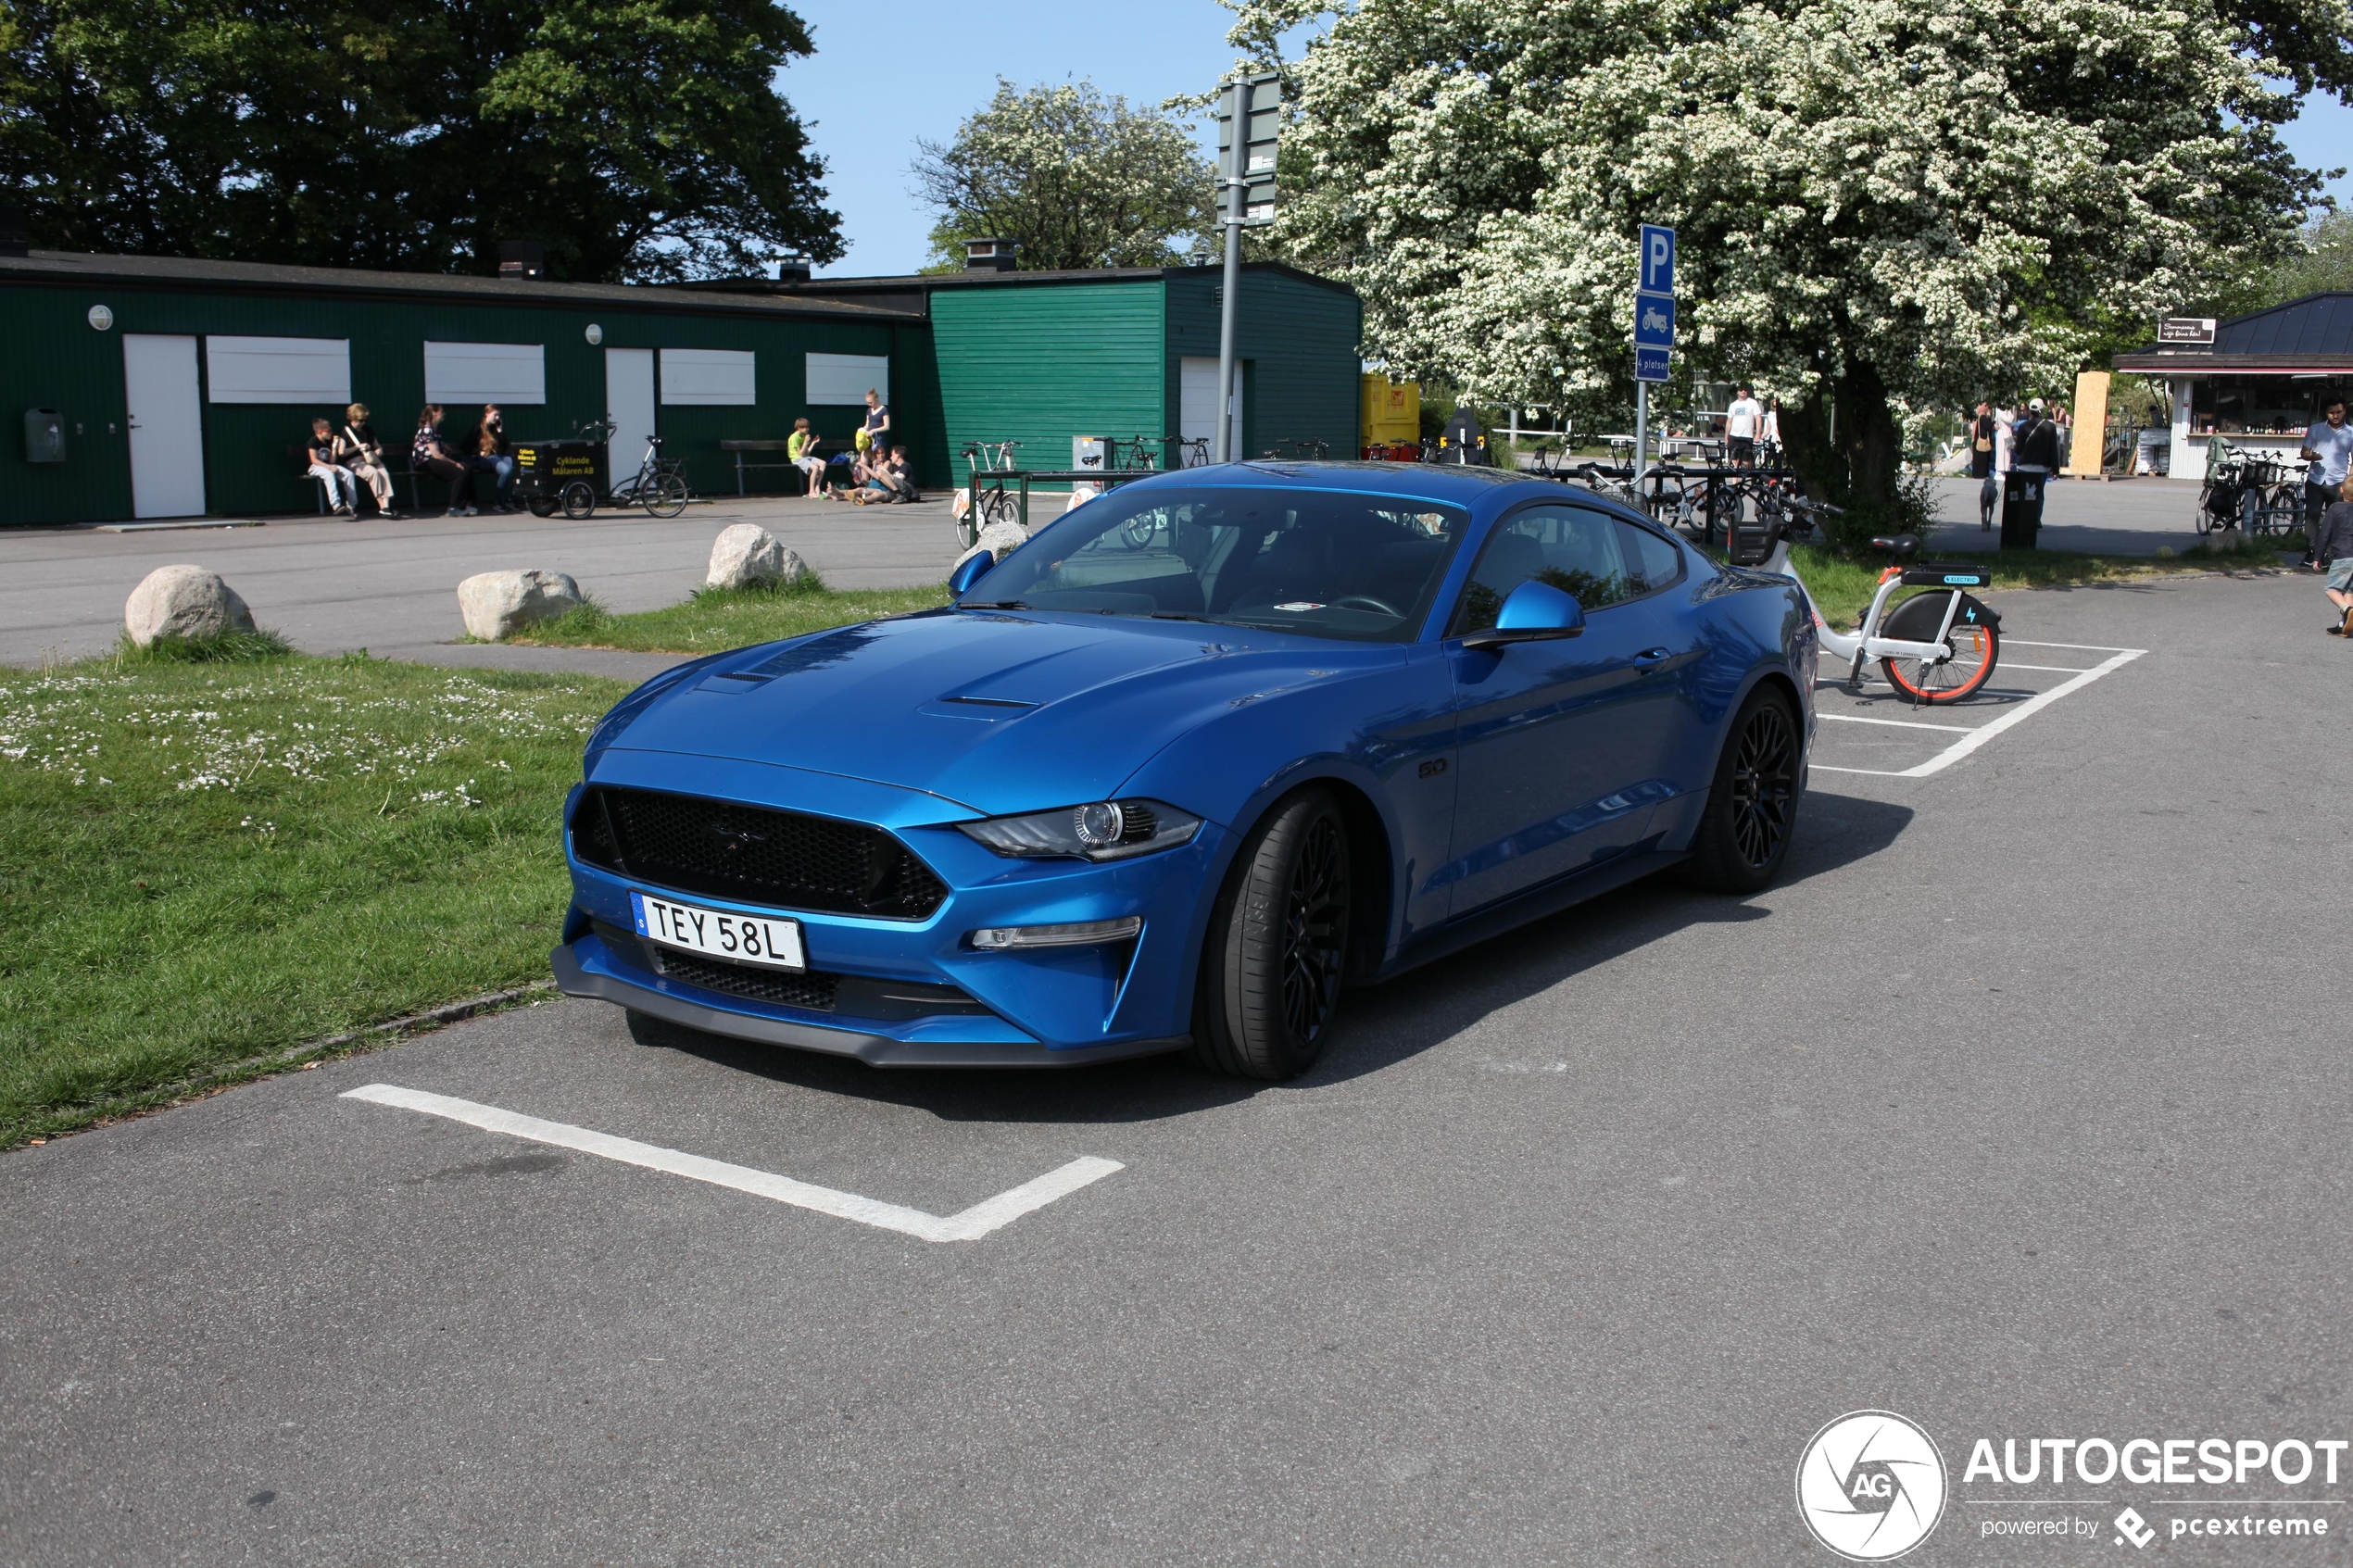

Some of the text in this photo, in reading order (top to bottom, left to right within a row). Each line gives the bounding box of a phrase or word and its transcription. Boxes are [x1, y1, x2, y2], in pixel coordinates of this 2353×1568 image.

[1649, 232, 1669, 286] P
[1638, 358, 1668, 370] 4 platser
[556, 457, 590, 466] Cyklande
[552, 467, 595, 475] Målaren AB
[638, 919, 645, 928] S
[651, 901, 786, 960] TEY 58L
